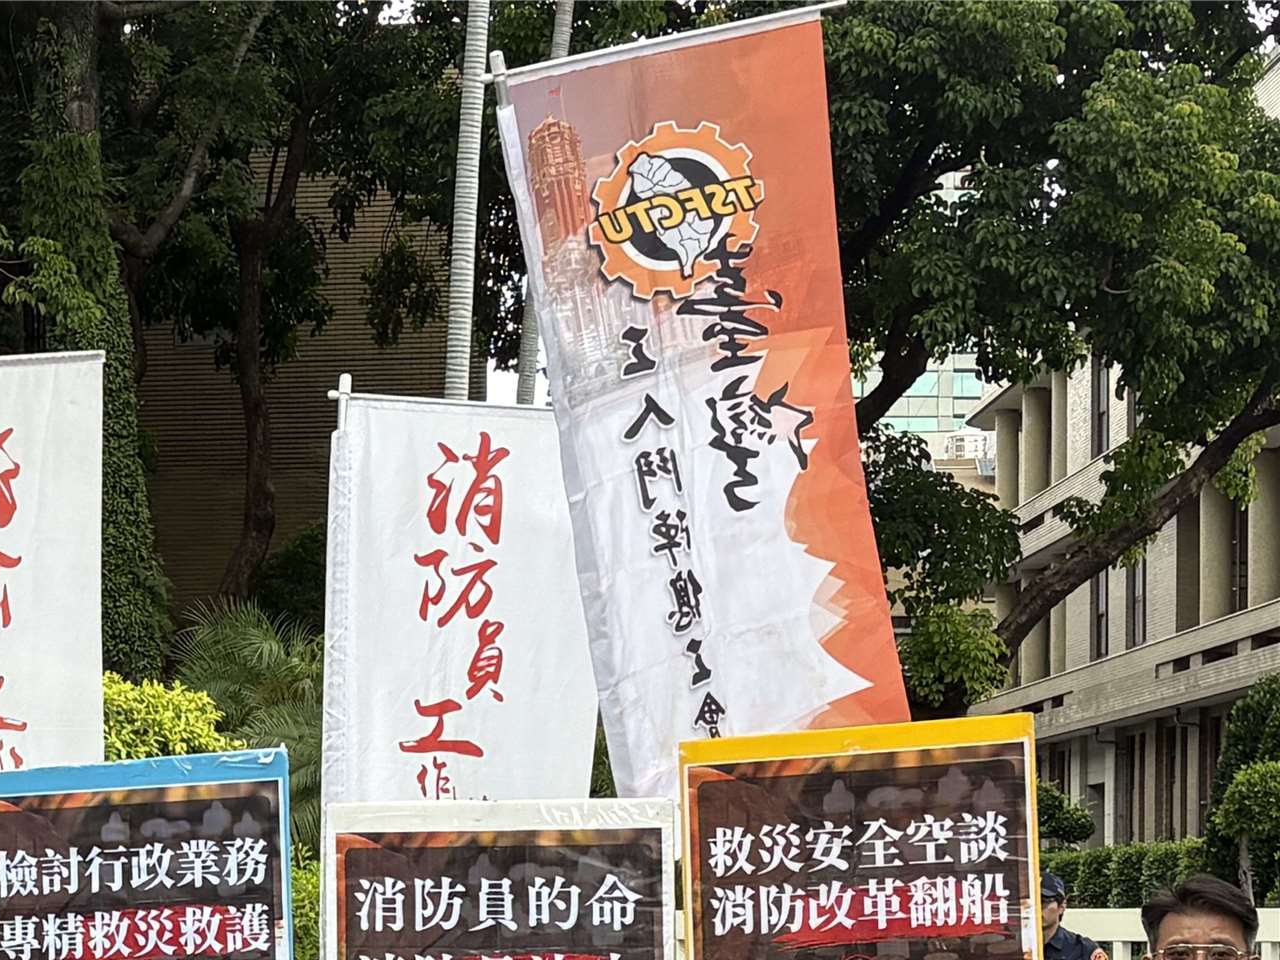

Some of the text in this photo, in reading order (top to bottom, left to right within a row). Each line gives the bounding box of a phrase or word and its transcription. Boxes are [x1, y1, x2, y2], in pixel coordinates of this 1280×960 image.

[708, 809, 1010, 878] 救災安全空談
[354, 873, 644, 933] 消防員的命
[709, 872, 1011, 938] 消防改革翻船
